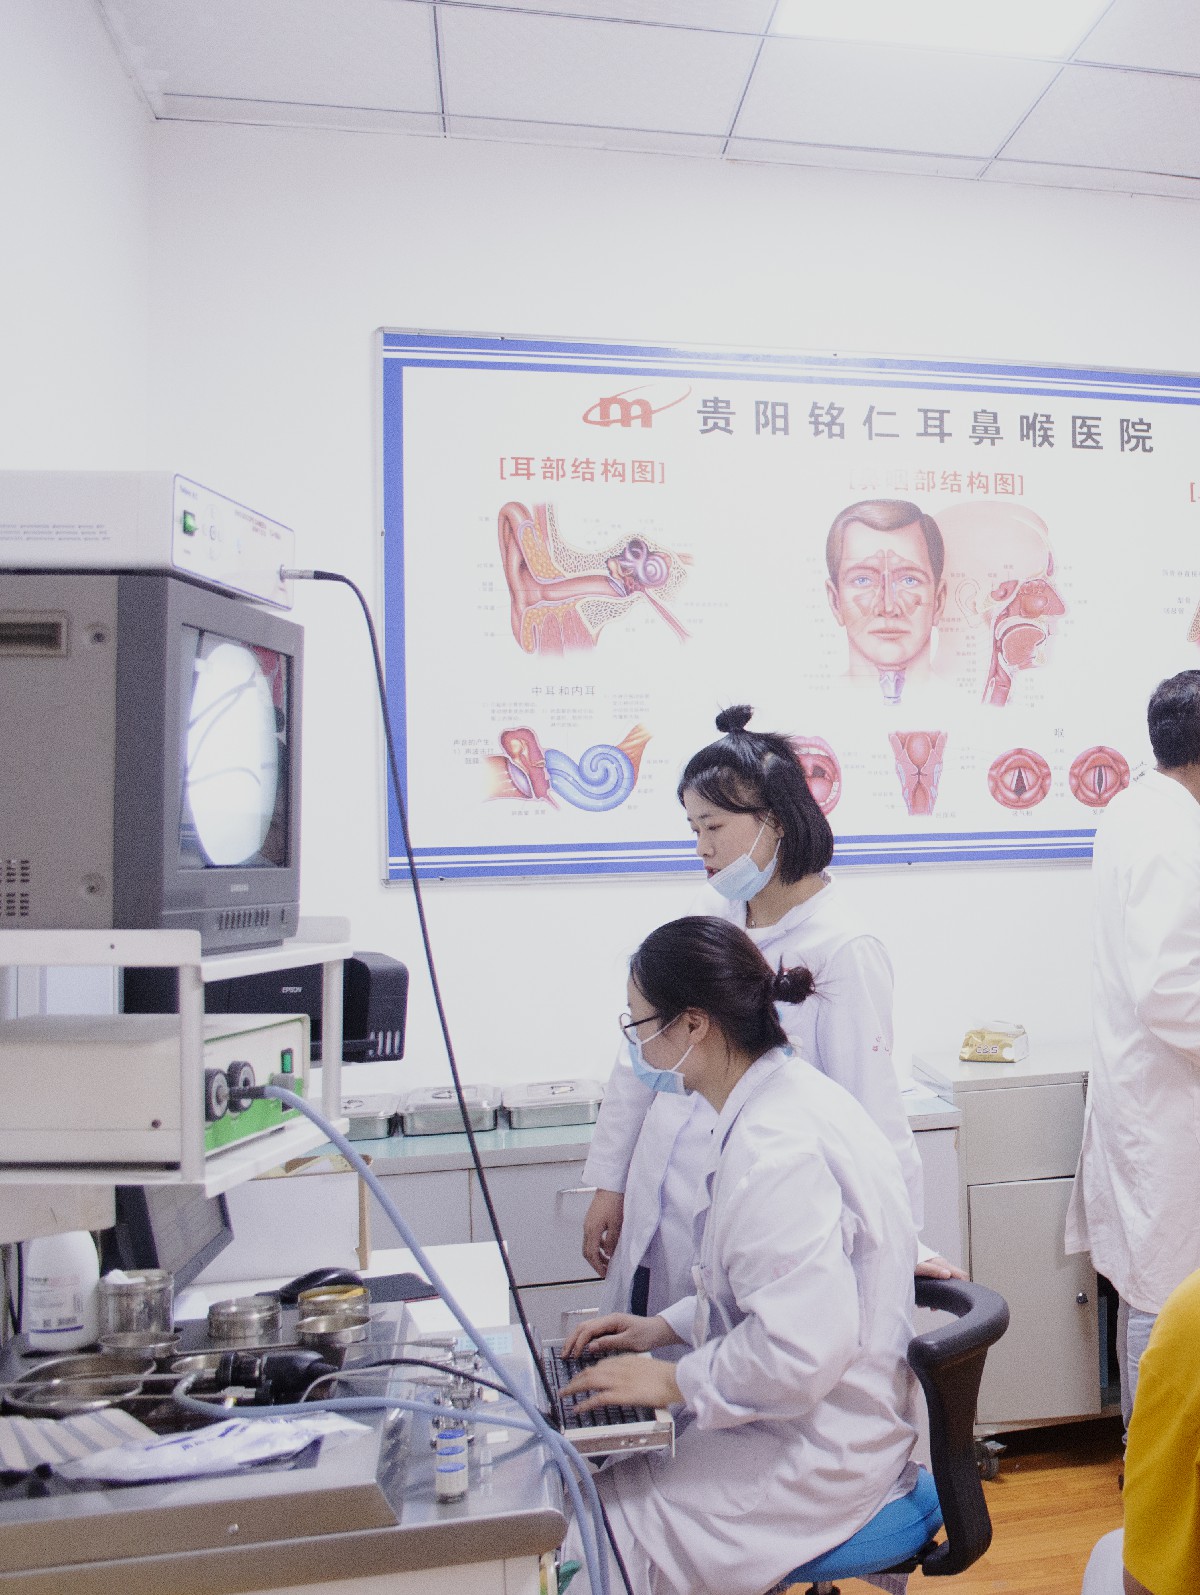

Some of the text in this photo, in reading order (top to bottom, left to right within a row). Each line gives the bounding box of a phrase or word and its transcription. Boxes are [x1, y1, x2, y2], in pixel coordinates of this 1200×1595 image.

[697, 396, 1154, 454] 贵阳铭仁耳鼻喉医院
[499, 456, 665, 485] [耳部结构图]
[531, 685, 597, 697] 中耳和内耳
[282, 986, 302, 994] EPSON
